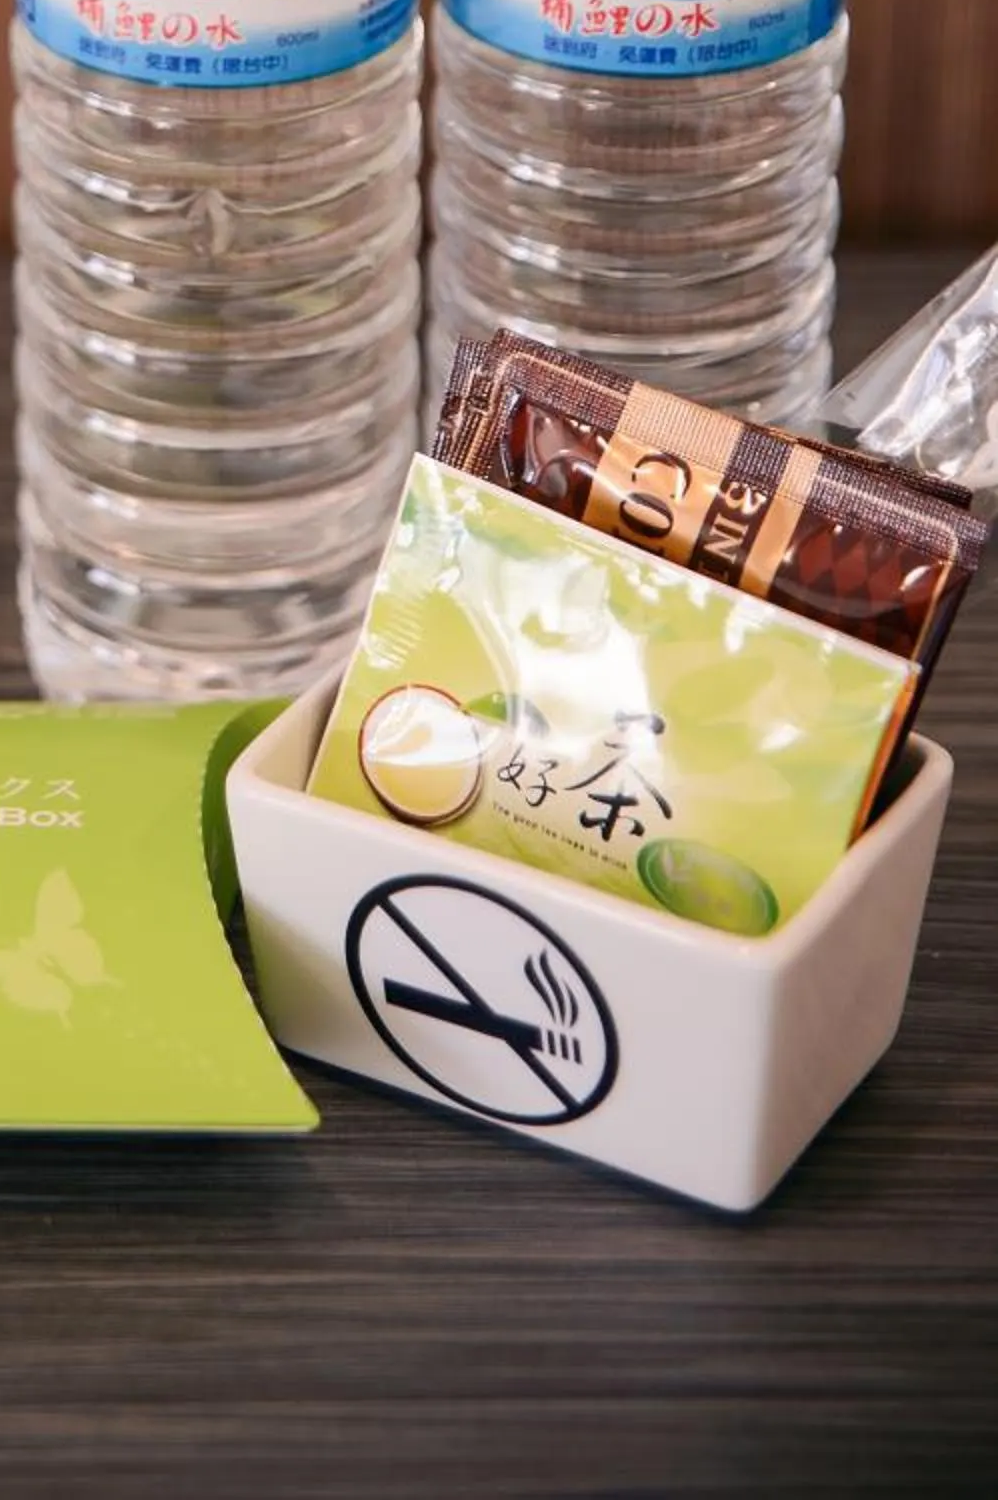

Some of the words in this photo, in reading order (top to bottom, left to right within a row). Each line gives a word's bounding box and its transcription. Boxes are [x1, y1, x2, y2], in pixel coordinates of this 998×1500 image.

[613, 452, 692, 554] CO
[723, 481, 767, 516] 3
[703, 514, 750, 565] IN
